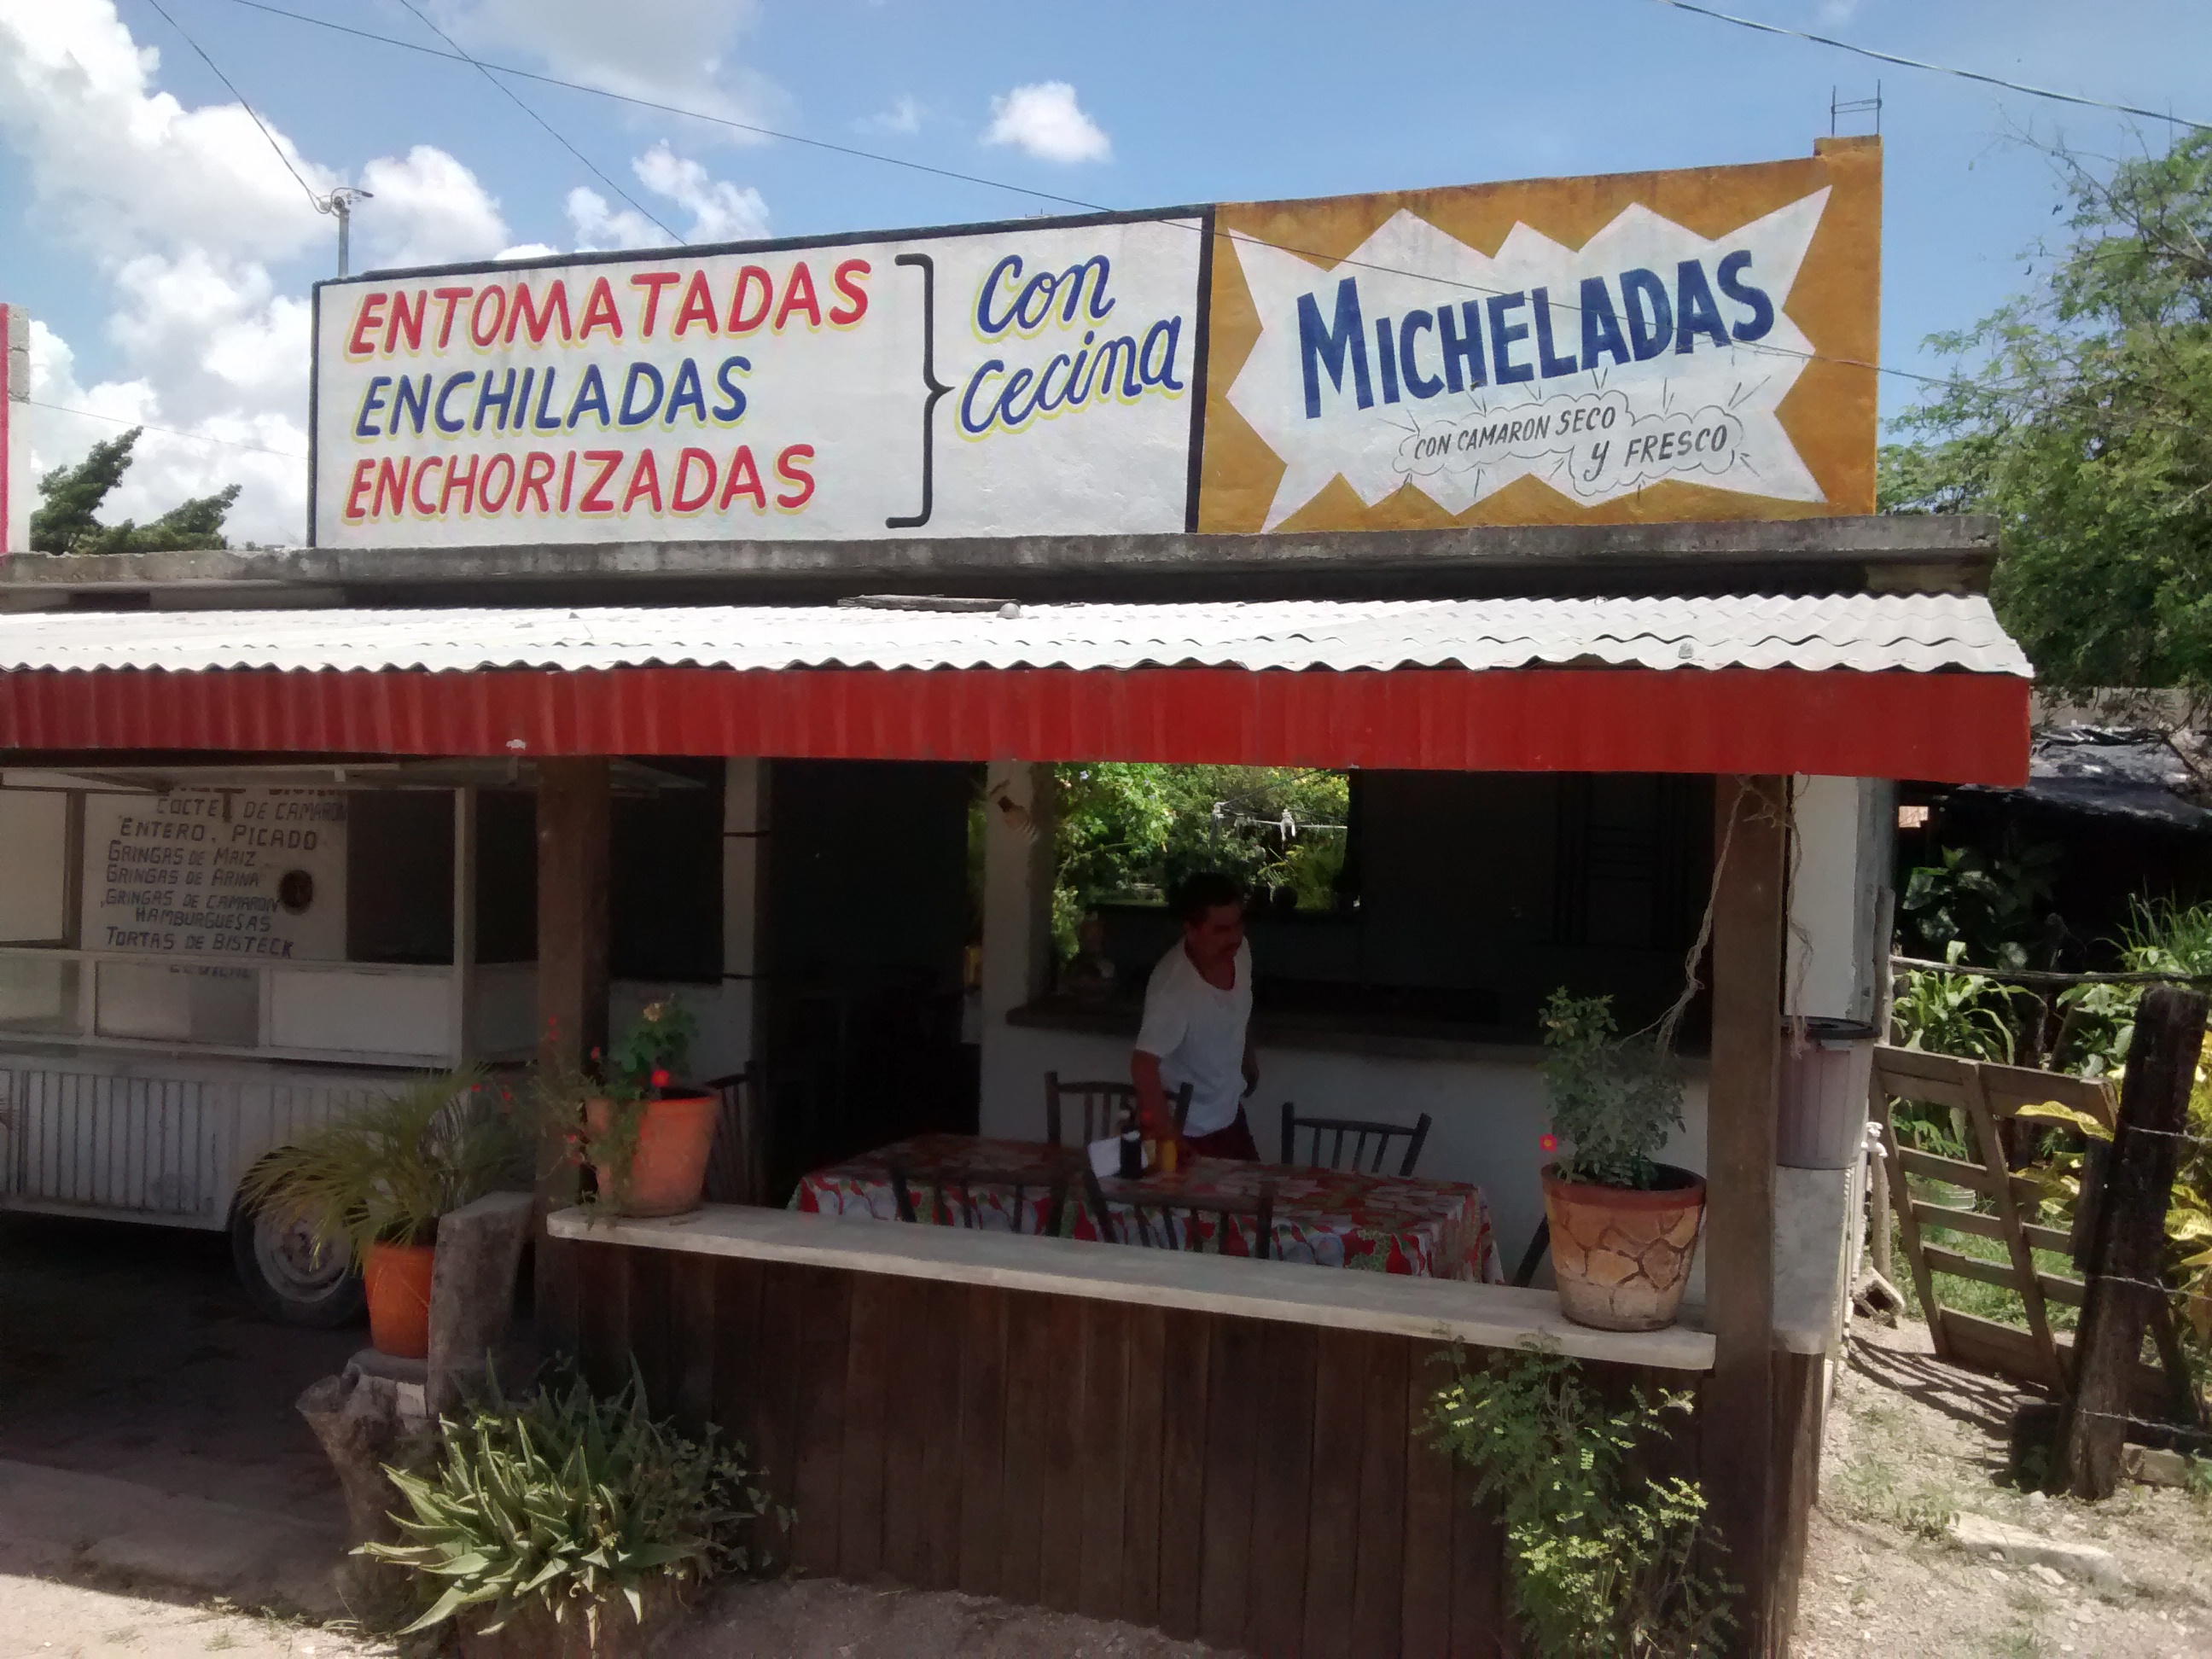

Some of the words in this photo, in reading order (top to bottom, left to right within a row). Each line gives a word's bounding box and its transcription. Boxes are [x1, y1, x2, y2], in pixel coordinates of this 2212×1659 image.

[347, 259, 872, 356] ENTOMATADAS
[975, 254, 1116, 334] Con
[1297, 249, 1775, 419] MICHELADAS
[354, 355, 752, 437] ENCHILADAS
[1413, 433, 1452, 461] CON
[1457, 414, 1551, 452] CAMARON
[1555, 405, 1616, 436] SECO
[1623, 423, 1728, 468] FRESCO
[344, 443, 815, 519] ENCHORIZADAS
[242, 800, 265, 820] DE
[107, 839, 183, 865] GRINGAS
[187, 849, 206, 866] DE
[212, 847, 257, 867] MAIZ
[230, 824, 317, 852] PICADO
[106, 864, 178, 885] GRINGAS
[184, 869, 203, 886] DE
[182, 893, 200, 908] DE
[135, 906, 272, 932] HAMBURGUESAS
[106, 925, 175, 950] TORTAS
[184, 934, 204, 951] DE
